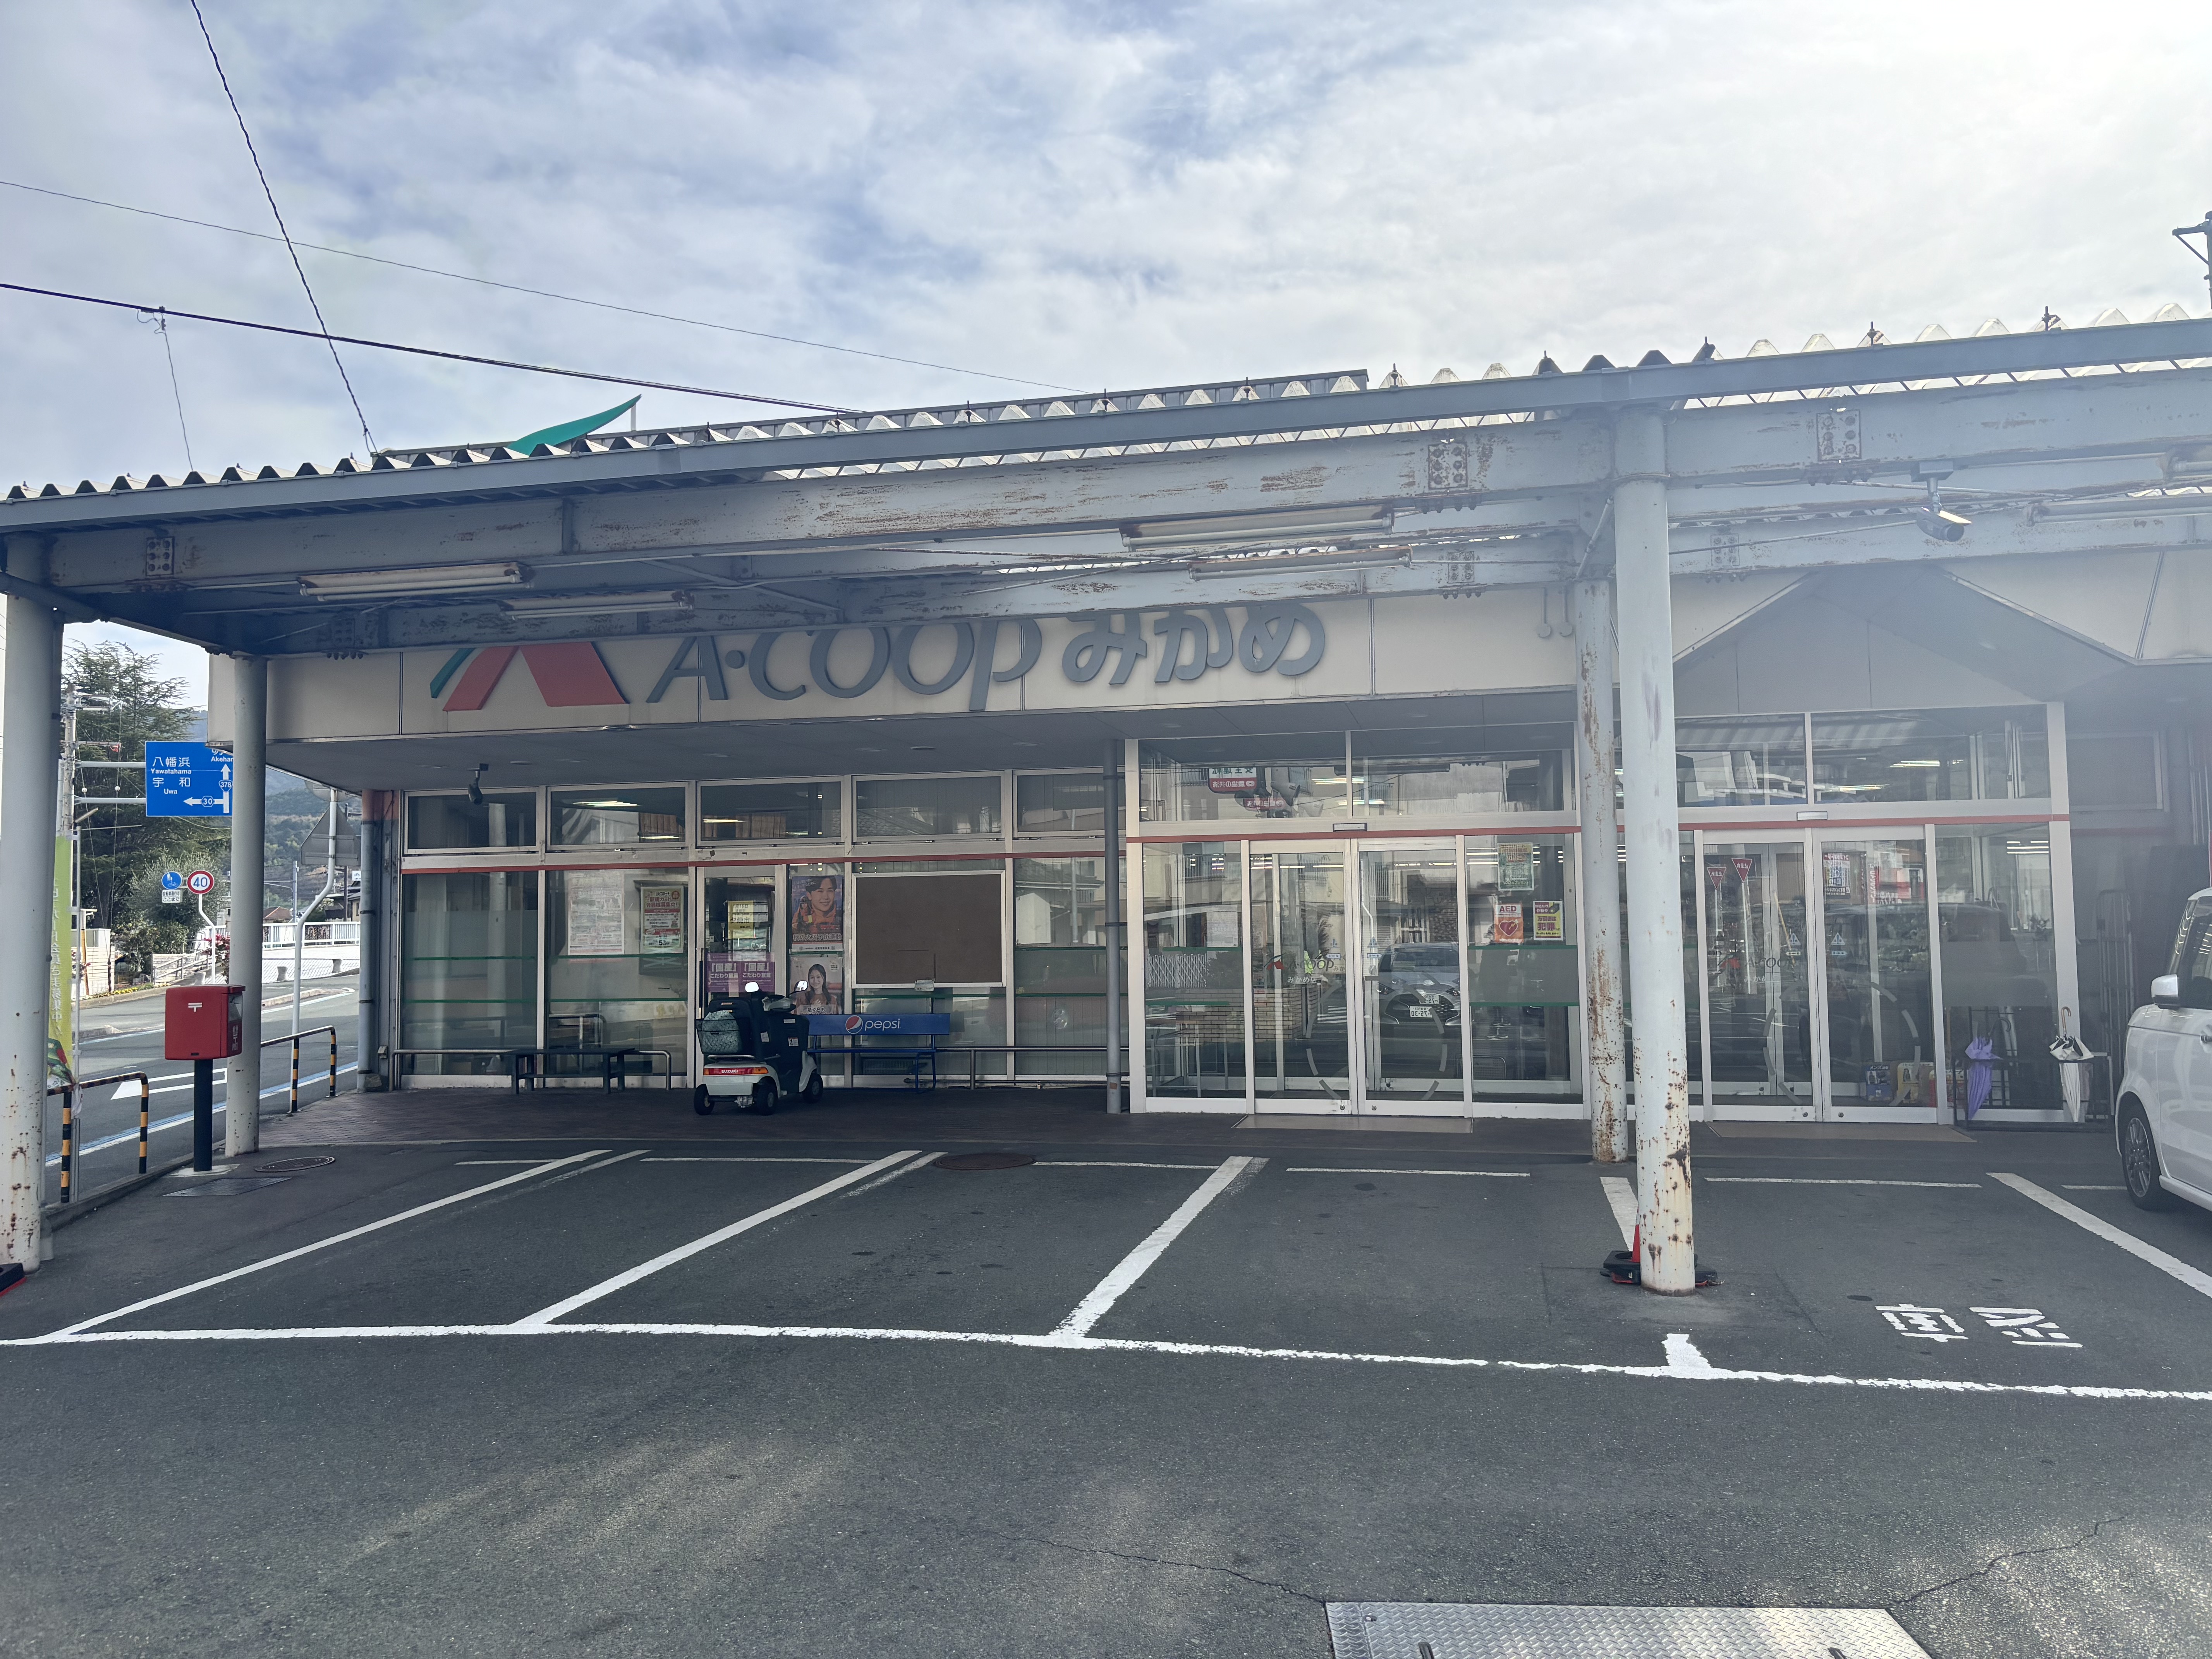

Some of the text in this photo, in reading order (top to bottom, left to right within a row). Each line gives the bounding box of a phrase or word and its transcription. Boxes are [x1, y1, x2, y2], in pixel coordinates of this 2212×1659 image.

[1061, 603, 1326, 686] みかめ
[152, 757, 190, 767] 八幡浜
[193, 877, 208, 887] 40
[864, 1018, 900, 1031] pepsi
